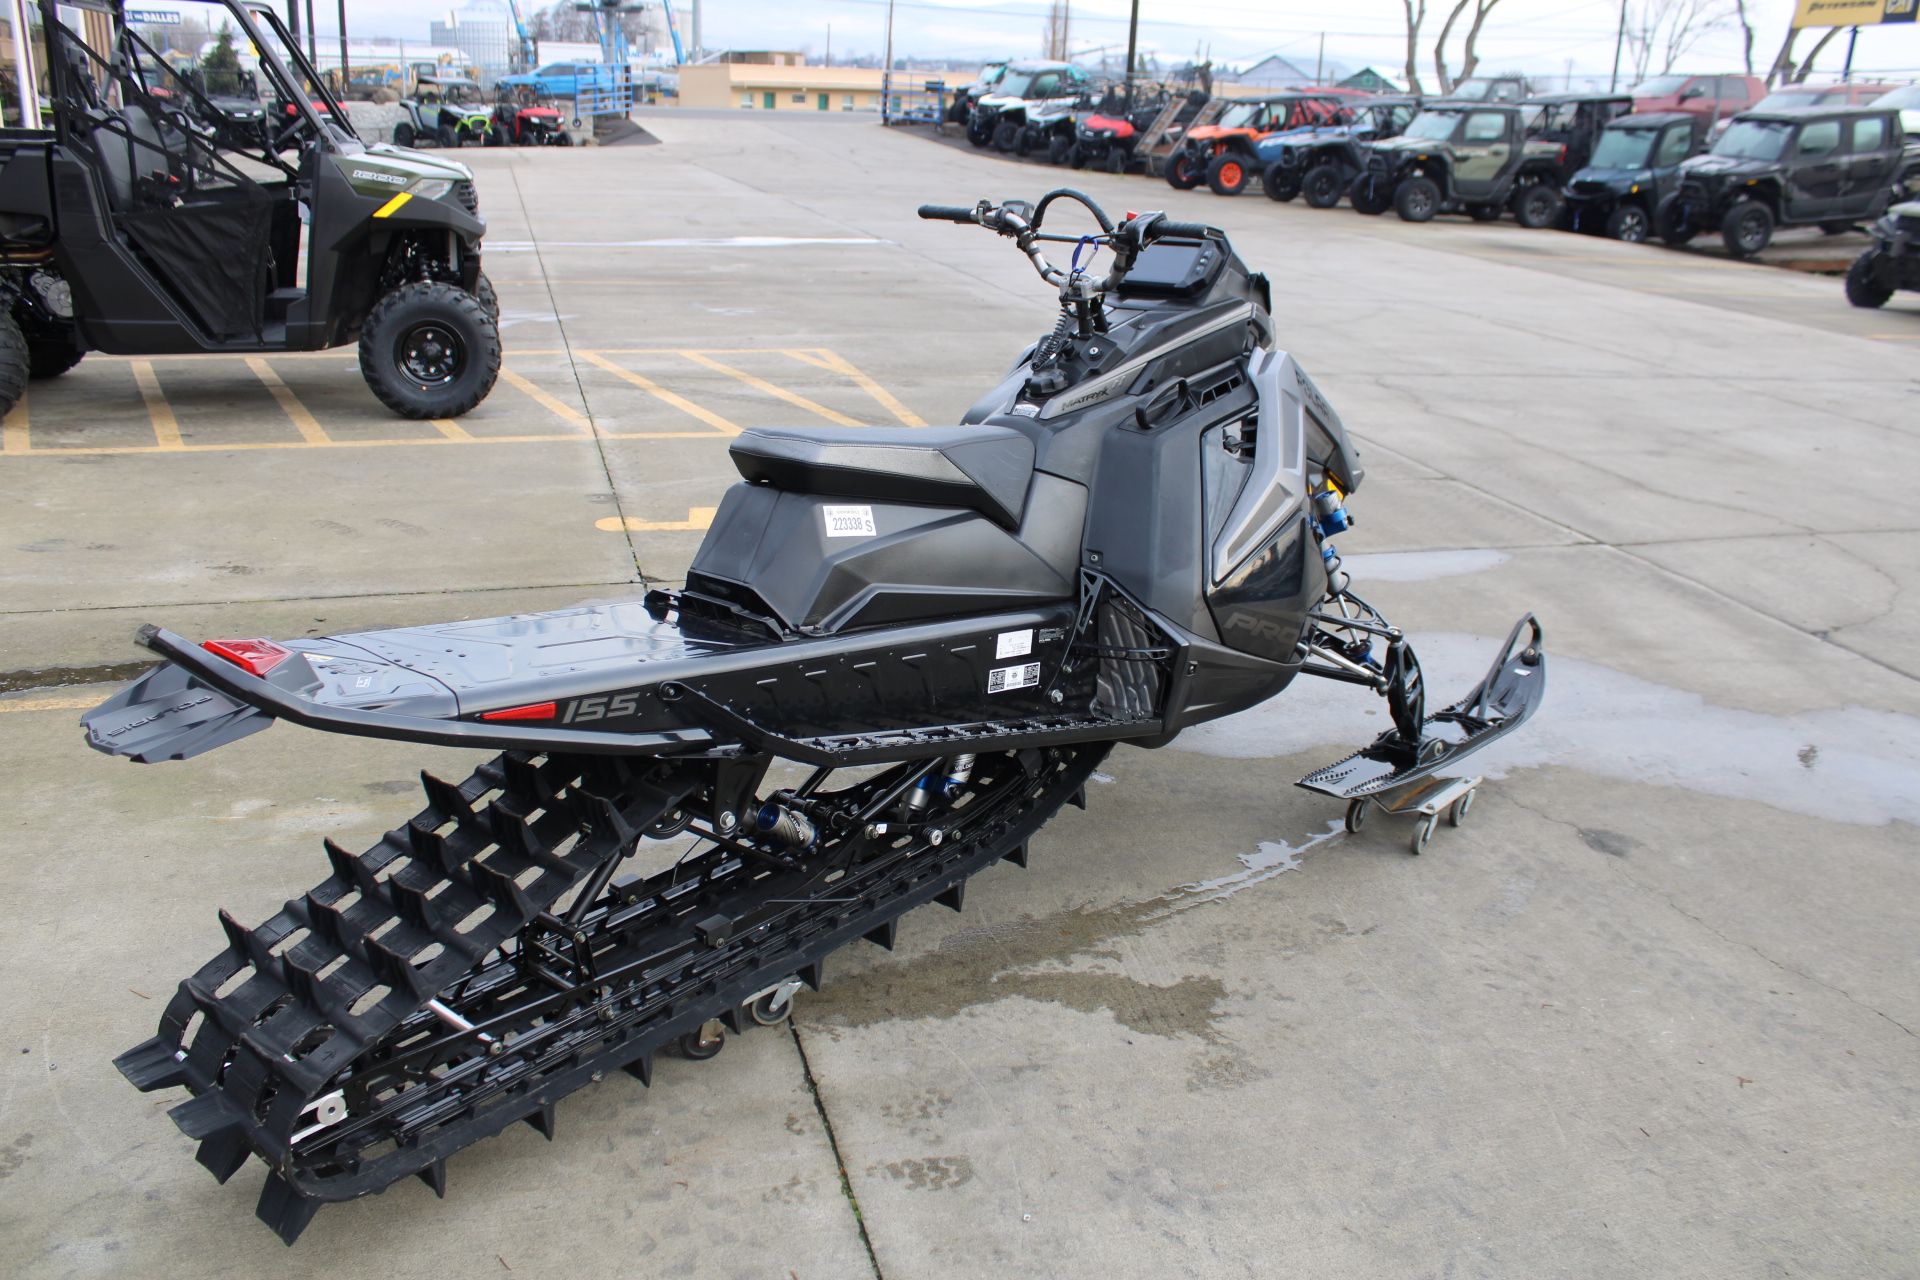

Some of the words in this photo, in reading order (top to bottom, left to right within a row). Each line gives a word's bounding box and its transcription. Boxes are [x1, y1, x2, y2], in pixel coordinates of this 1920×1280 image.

[1062, 386, 1109, 411] MATRYX
[833, 517, 863, 531] 223338
[865, 519, 873, 532] S
[1223, 612, 1299, 644] PRO
[107, 695, 213, 737] POLARIS
[562, 692, 640, 724] 155
